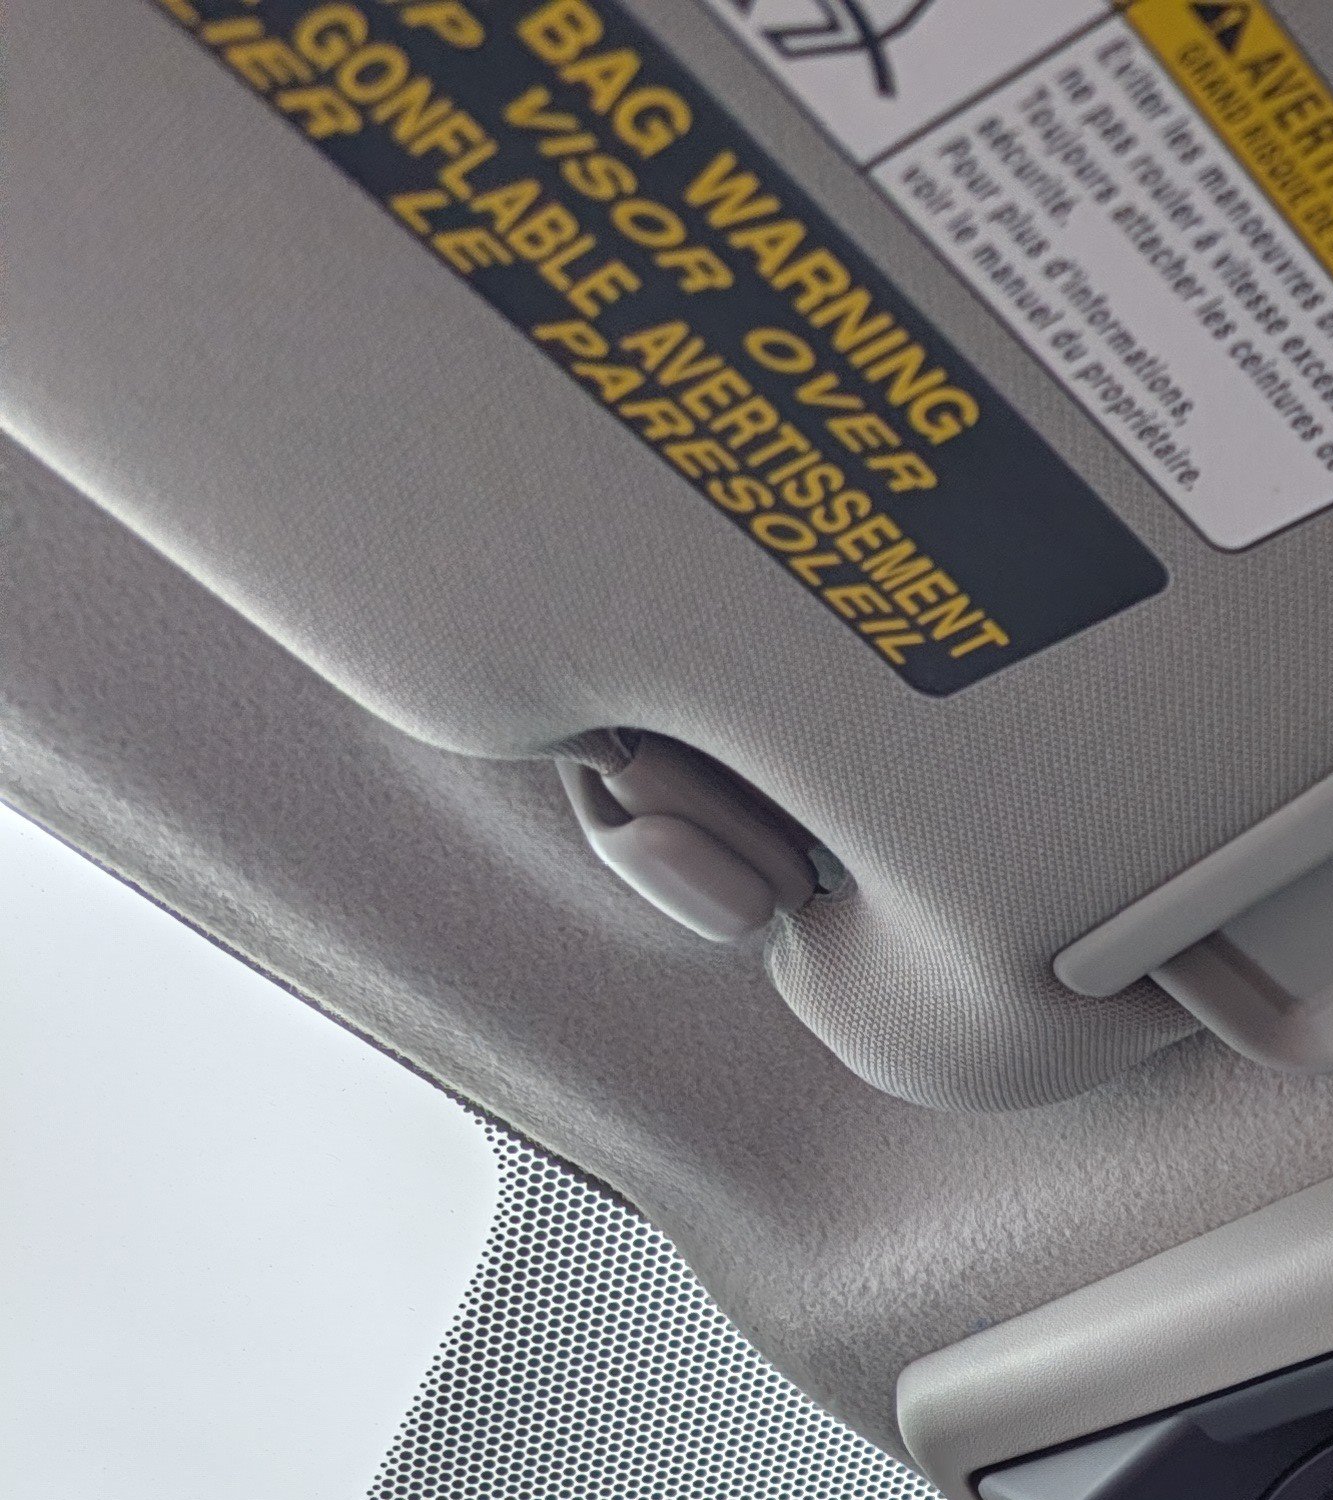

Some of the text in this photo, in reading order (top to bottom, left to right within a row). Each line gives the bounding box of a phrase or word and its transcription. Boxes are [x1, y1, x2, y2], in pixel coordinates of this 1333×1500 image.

[294, 3, 1010, 659] GONFLABLE AVERTISSEMENT
[505, 84, 735, 293] VISOR
[743, 326, 938, 493] OVER
[515, 0, 981, 444] BAG WARNING
[902, 165, 954, 215] voir
[946, 209, 978, 244] le
[972, 242, 1066, 331] manuel
[1048, 327, 1089, 363] du
[940, 134, 1001, 201] Pour
[987, 202, 1050, 259] plus
[1019, 83, 1119, 203] Toujours
[1111, 204, 1206, 301] attacher
[1197, 295, 1237, 341] les
[1229, 340, 1324, 443] ceintures
[1057, 67, 1096, 103] ne
[1080, 103, 1139, 156] pas
[1127, 153, 1203, 231] rouler
[1211, 251, 1289, 335] vitesse
[1162, 117, 1206, 165] les
[1200, 164, 1325, 312] manoeuvres
[389, 190, 514, 273] LE
[532, 319, 925, 666] PARESOLEIL
